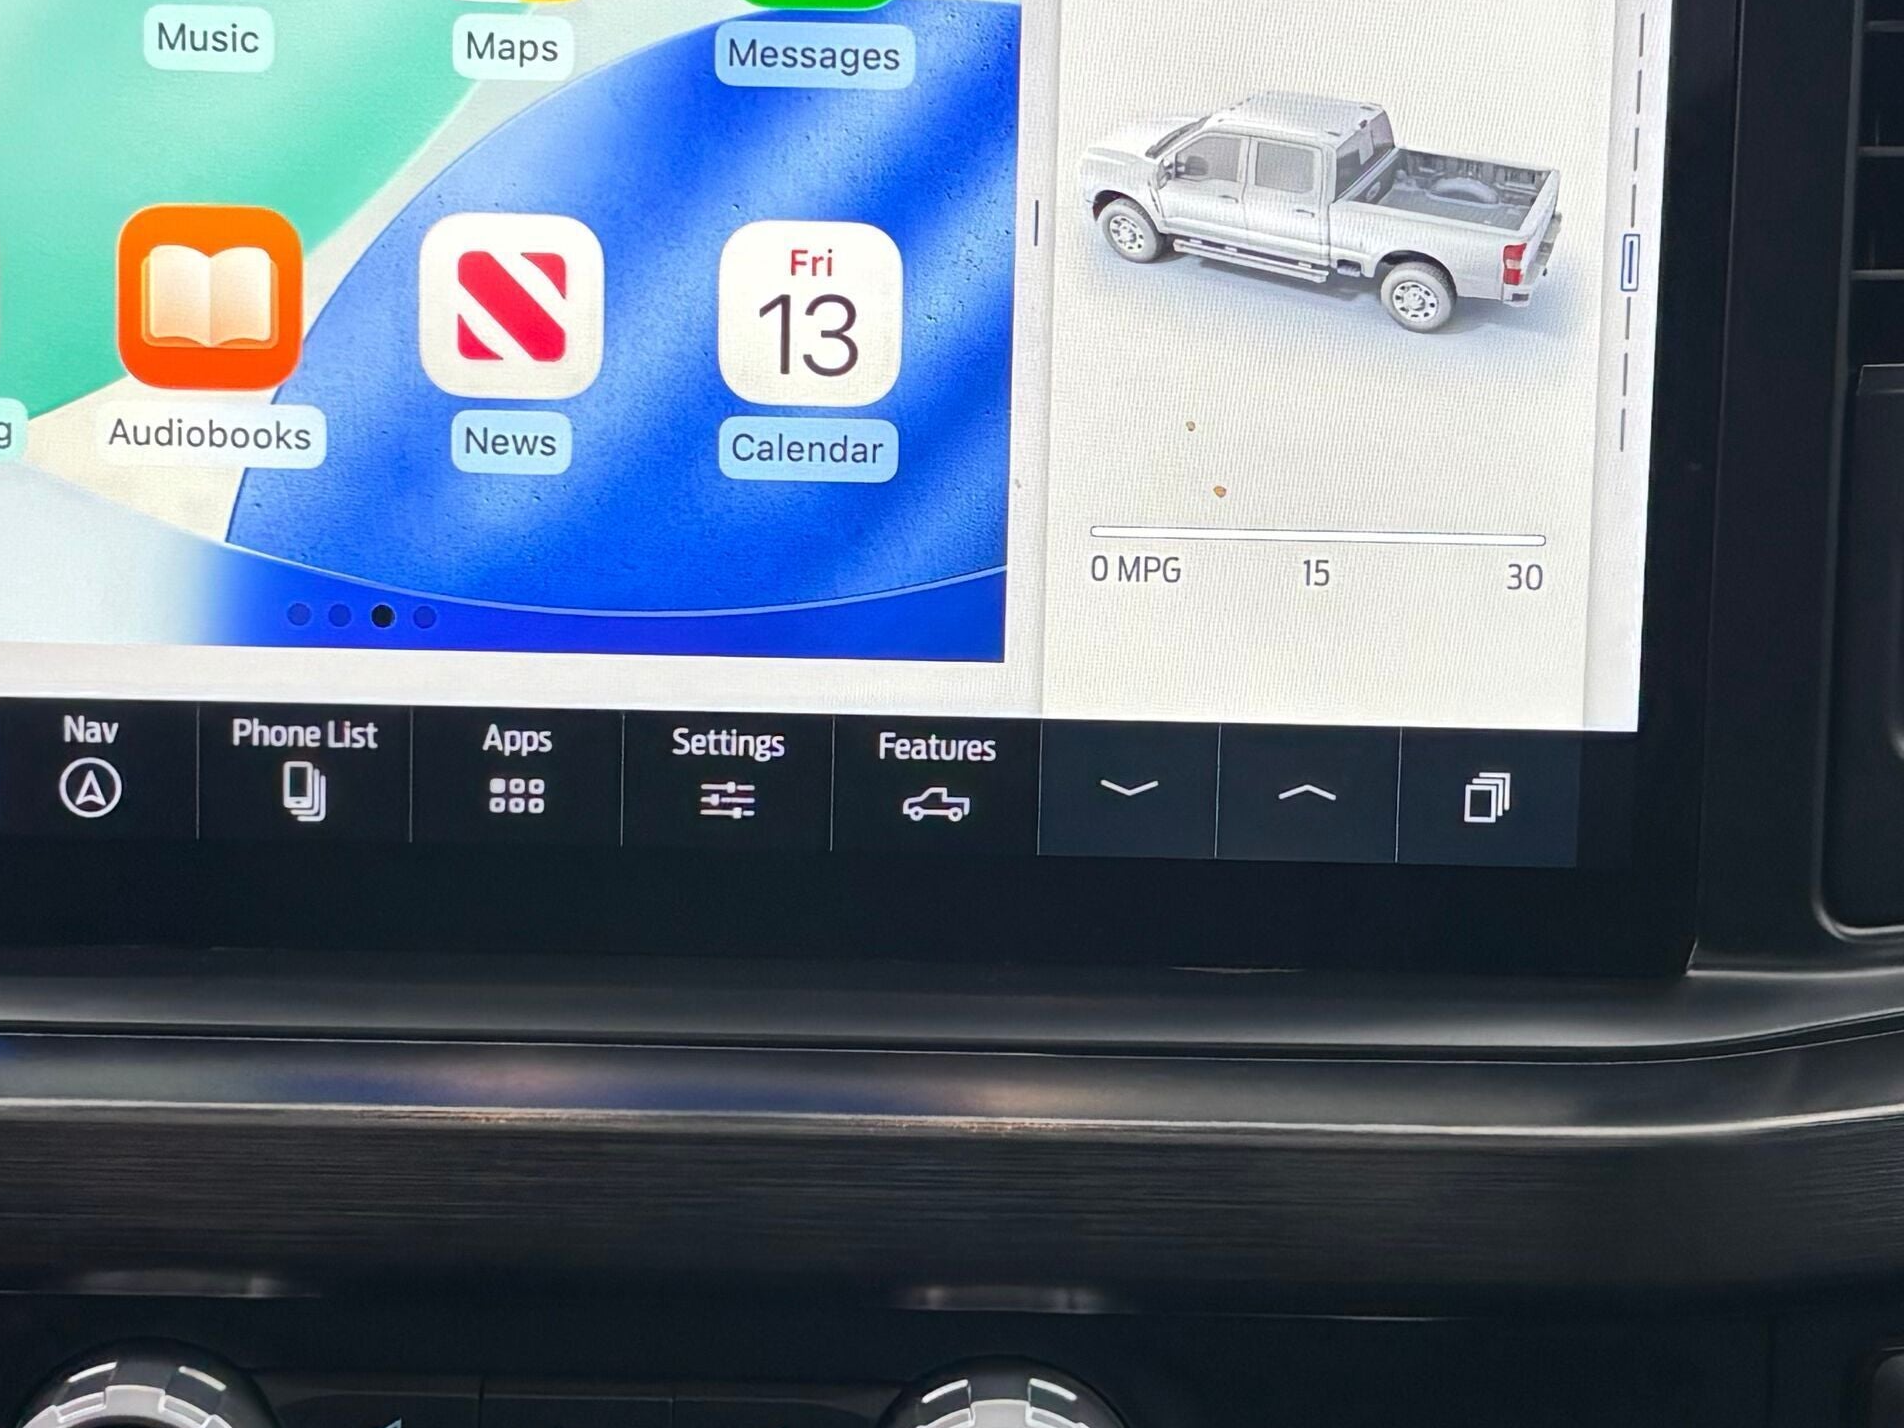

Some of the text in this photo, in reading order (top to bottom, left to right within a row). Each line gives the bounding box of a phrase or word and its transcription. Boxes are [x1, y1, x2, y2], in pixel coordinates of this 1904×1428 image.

[156, 24, 260, 54] Music
[466, 30, 559, 68] Maps
[727, 37, 901, 74] Messages
[789, 248, 834, 276] Fri
[758, 294, 859, 377] 13
[108, 417, 312, 452] Audiobooks
[464, 427, 557, 457] News
[731, 433, 884, 465] Calendar
[1091, 556, 1182, 585] 0 MPG
[1303, 559, 1331, 587] 15
[1506, 563, 1544, 591] 30
[63, 715, 120, 744] Nav
[232, 718, 378, 750] Phone List
[482, 725, 553, 756] Apps
[672, 728, 786, 760] Settings
[878, 732, 997, 762] Features
